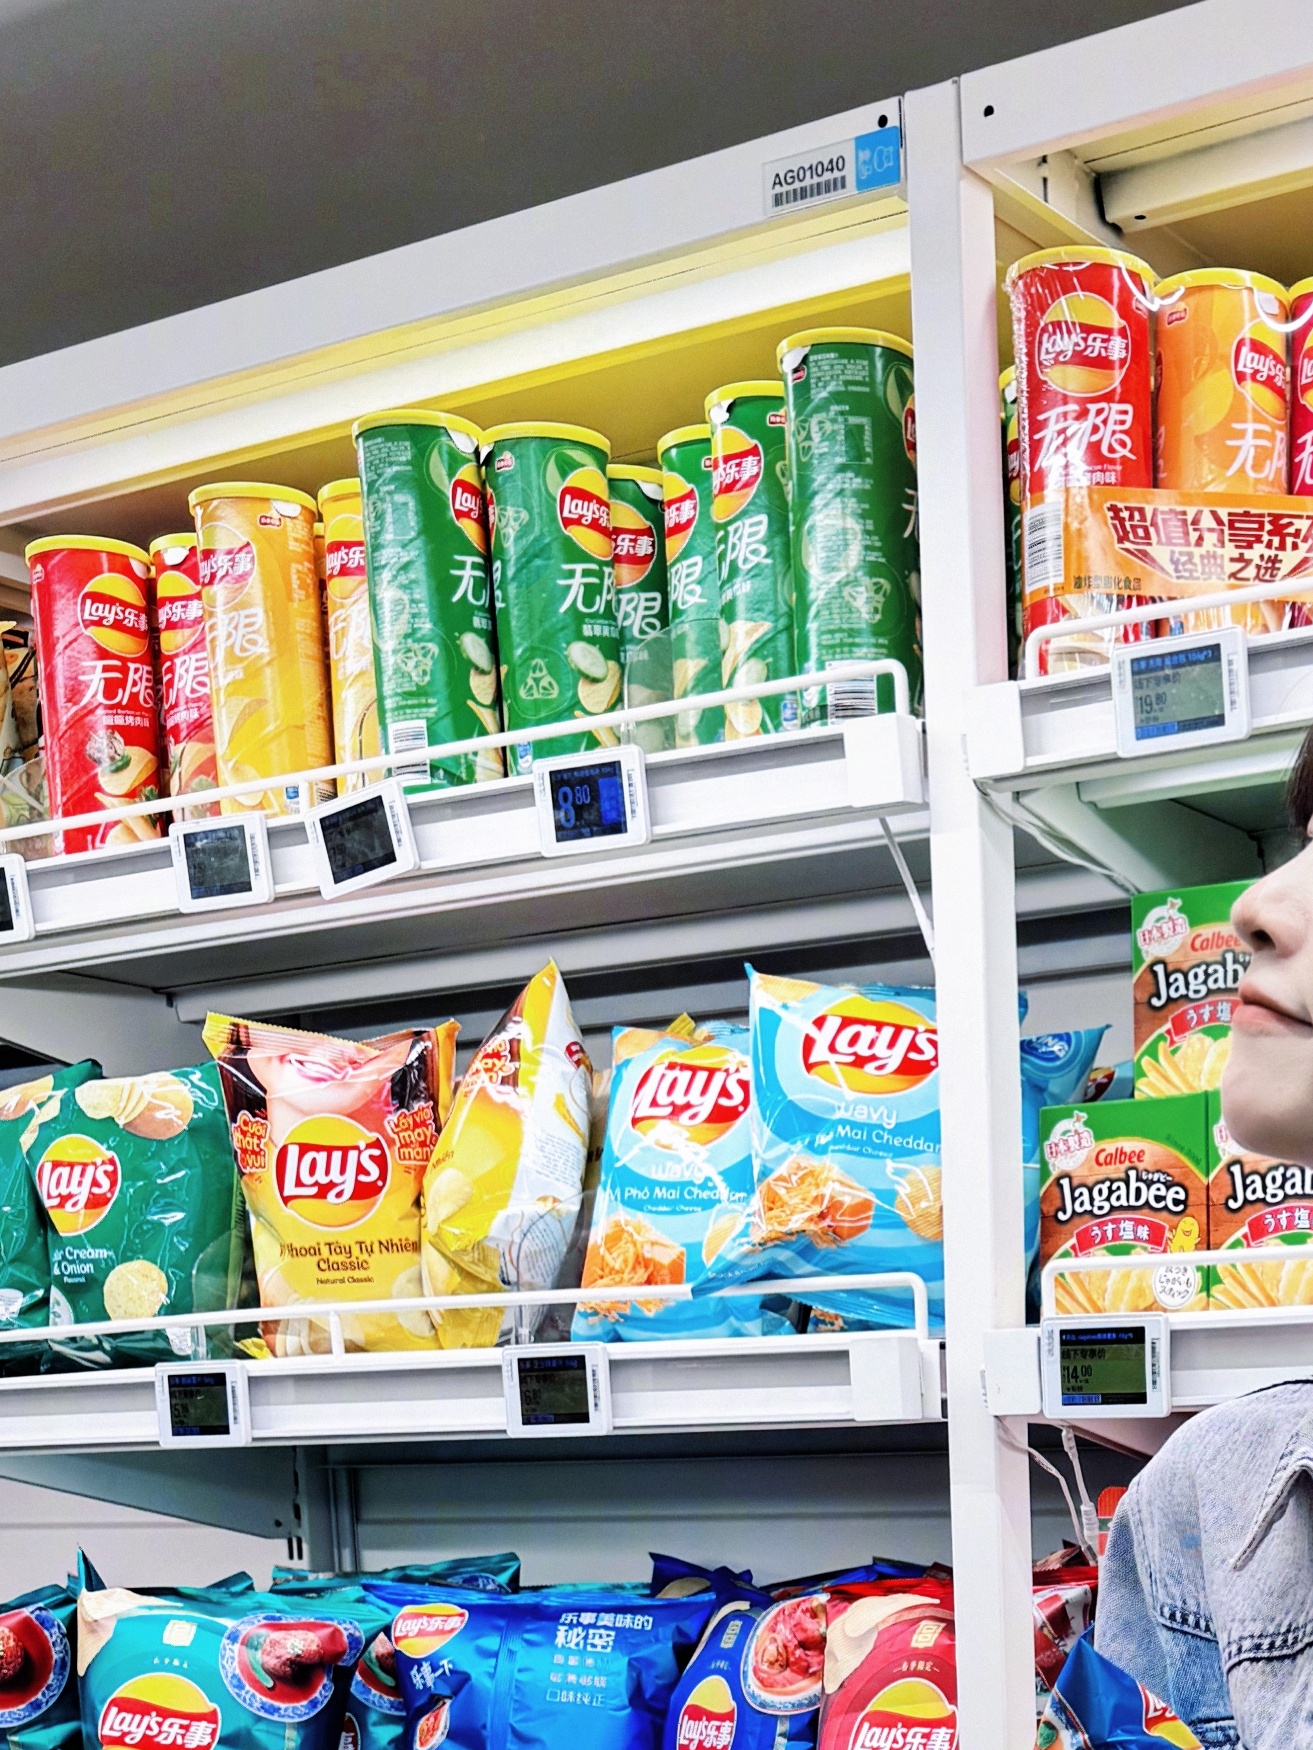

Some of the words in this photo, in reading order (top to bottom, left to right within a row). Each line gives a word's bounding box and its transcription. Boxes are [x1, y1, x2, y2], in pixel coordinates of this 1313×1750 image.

[772, 155, 846, 190] AG01040
[1237, 349, 1286, 385] Lay's乐
[562, 494, 612, 528] Lay's乐
[1169, 551, 1284, 584] 经典之选
[79, 660, 157, 708] 无限
[1150, 951, 1246, 1008] Jagab
[1186, 1001, 1232, 1029] うす塩
[808, 1014, 940, 1074] Lay's
[630, 1062, 750, 1128] Lay's
[871, 1129, 940, 1154] Cheddar
[1094, 1147, 1146, 1168] Calbee
[38, 1156, 117, 1213] Lay's
[282, 1140, 384, 1206] Lay's
[1057, 1169, 1186, 1222] Jagabee
[1090, 1220, 1150, 1244] うす塩味
[62, 1261, 94, 1275] Onion
[66, 1245, 109, 1261] Cream
[316, 1258, 371, 1273] Classic
[394, 1606, 465, 1637] Lay's乐事
[559, 1611, 654, 1631] 乐事美味的
[555, 1624, 616, 1654] 秘密
[101, 1705, 219, 1750] Lay's乐事
